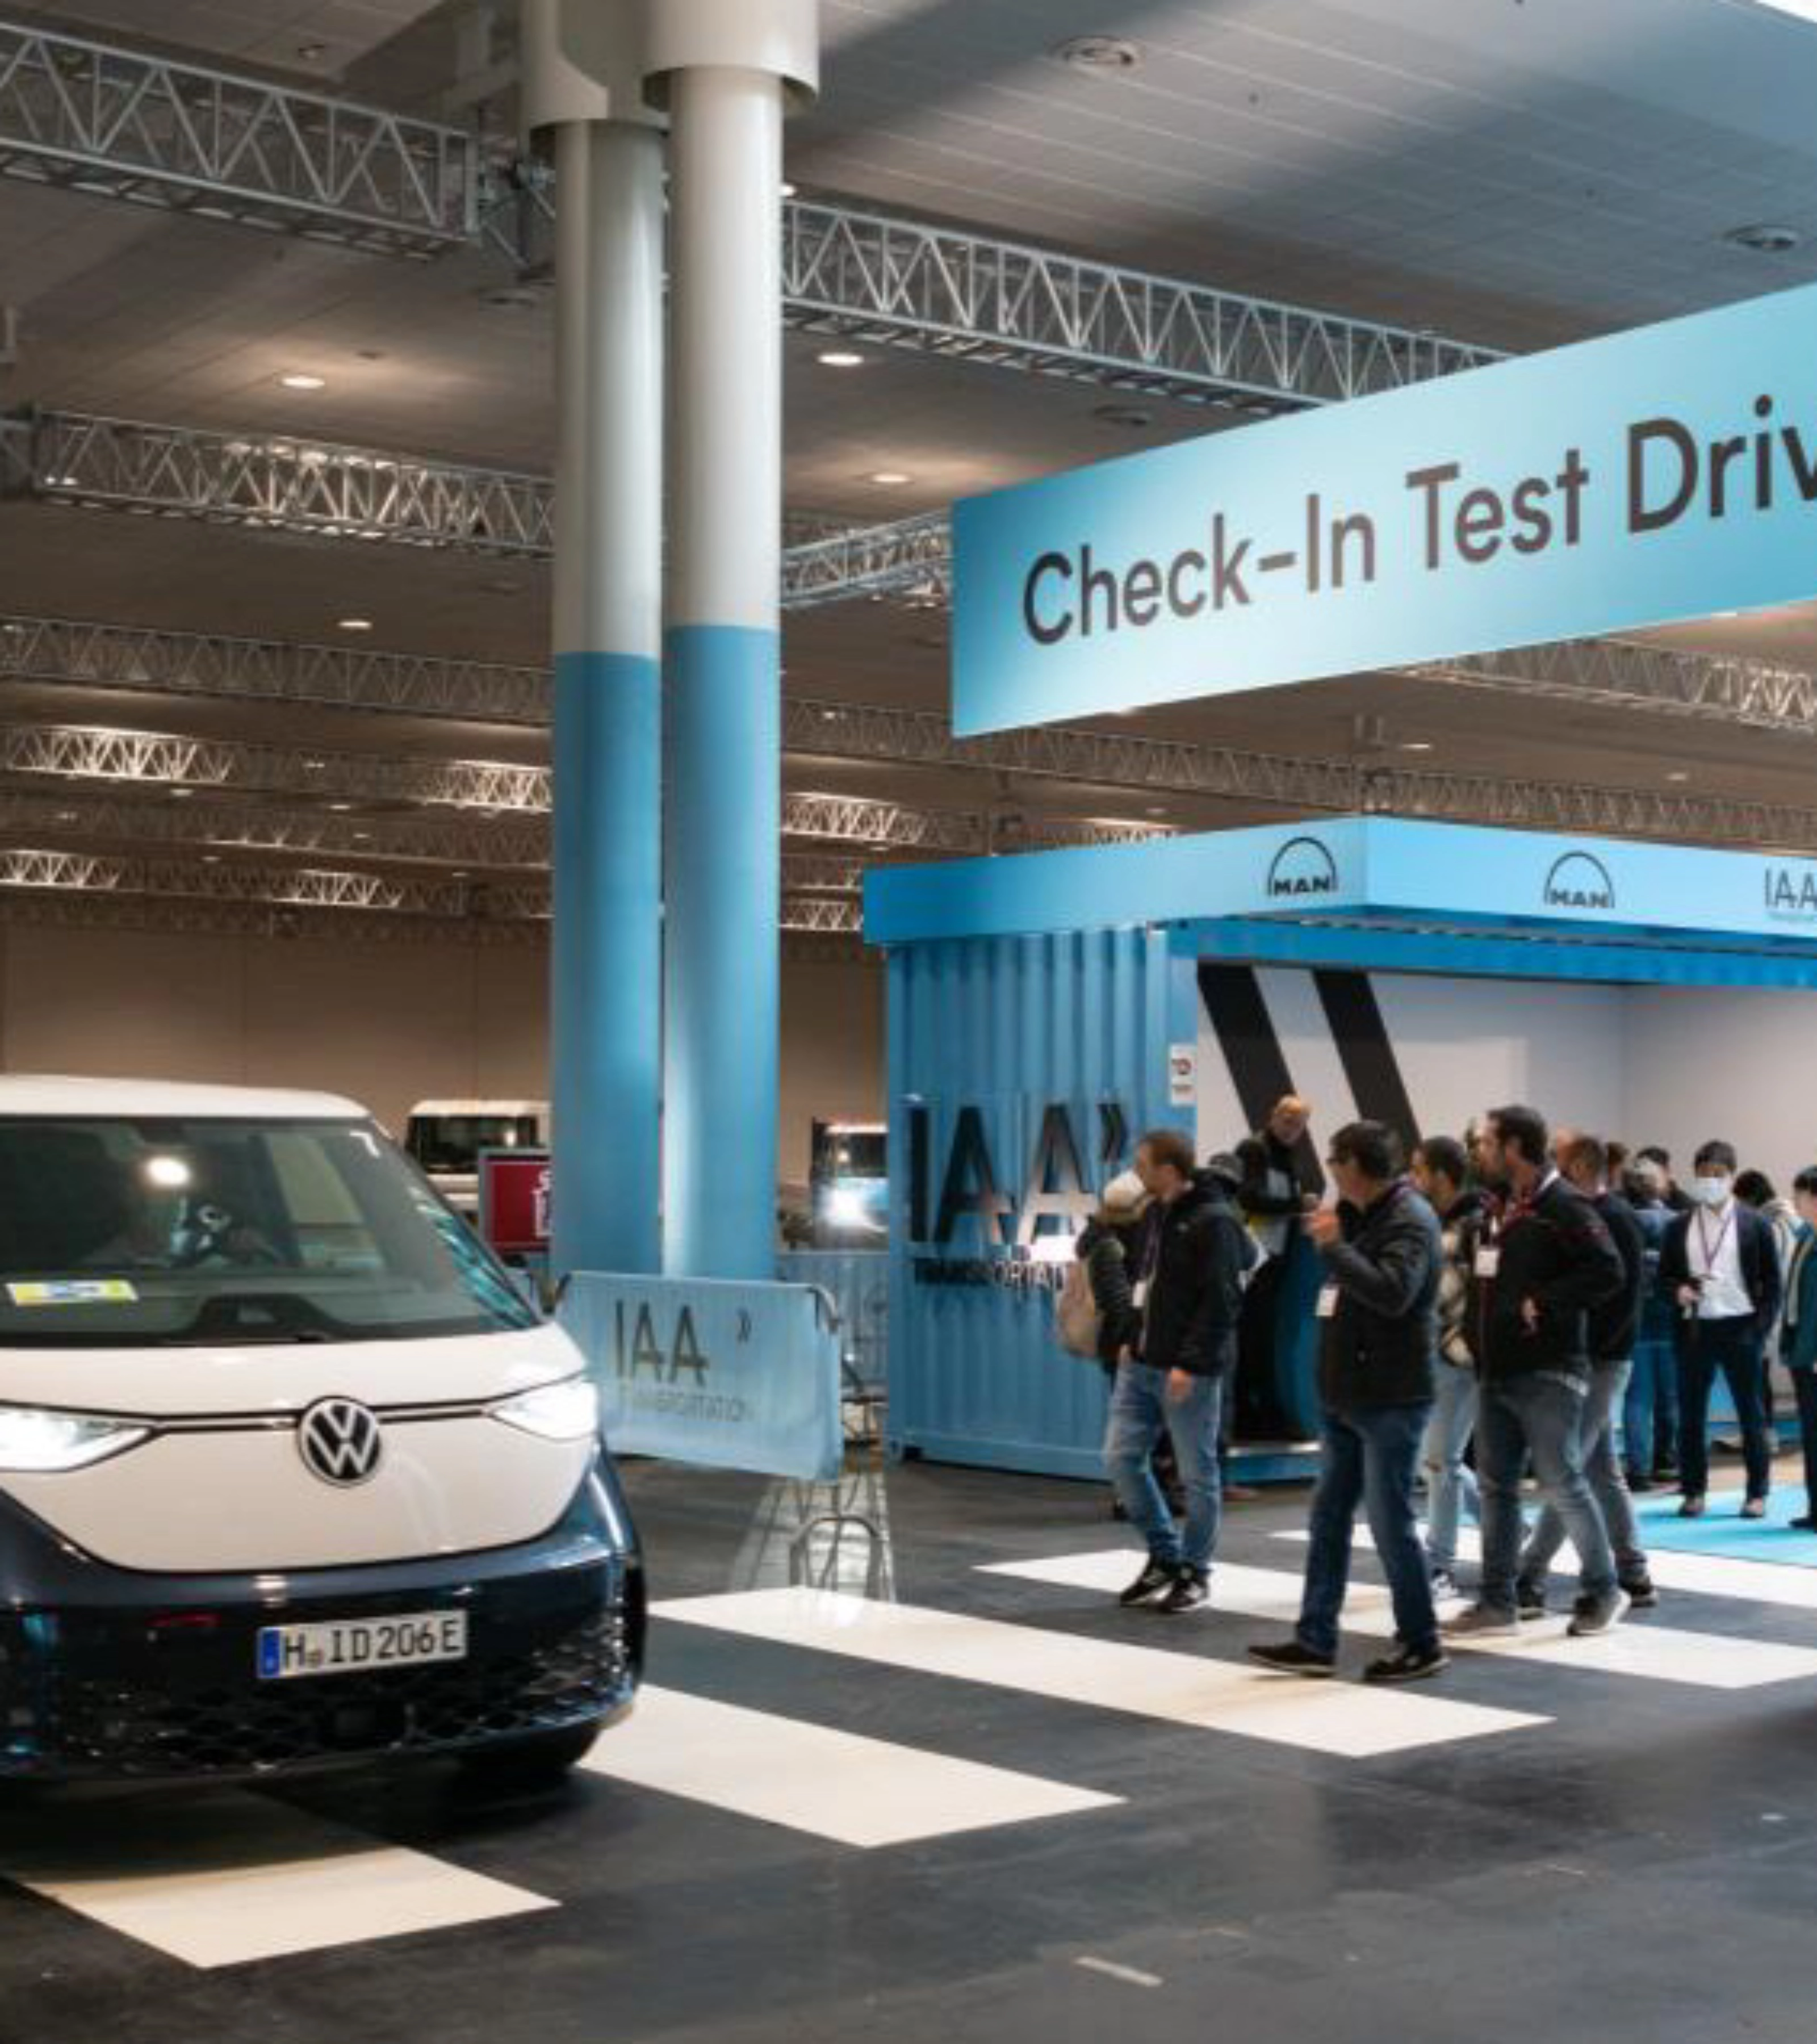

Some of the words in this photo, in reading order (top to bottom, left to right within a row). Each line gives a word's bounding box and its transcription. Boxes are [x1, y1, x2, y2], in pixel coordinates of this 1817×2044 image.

[1024, 493, 1375, 646] Check-In
[1405, 449, 1588, 569] Test
[1274, 875, 1330, 895] MAN
[1550, 888, 1609, 909] MAN
[1764, 868, 1817, 911] IAA
[615, 1299, 709, 1387] IAA
